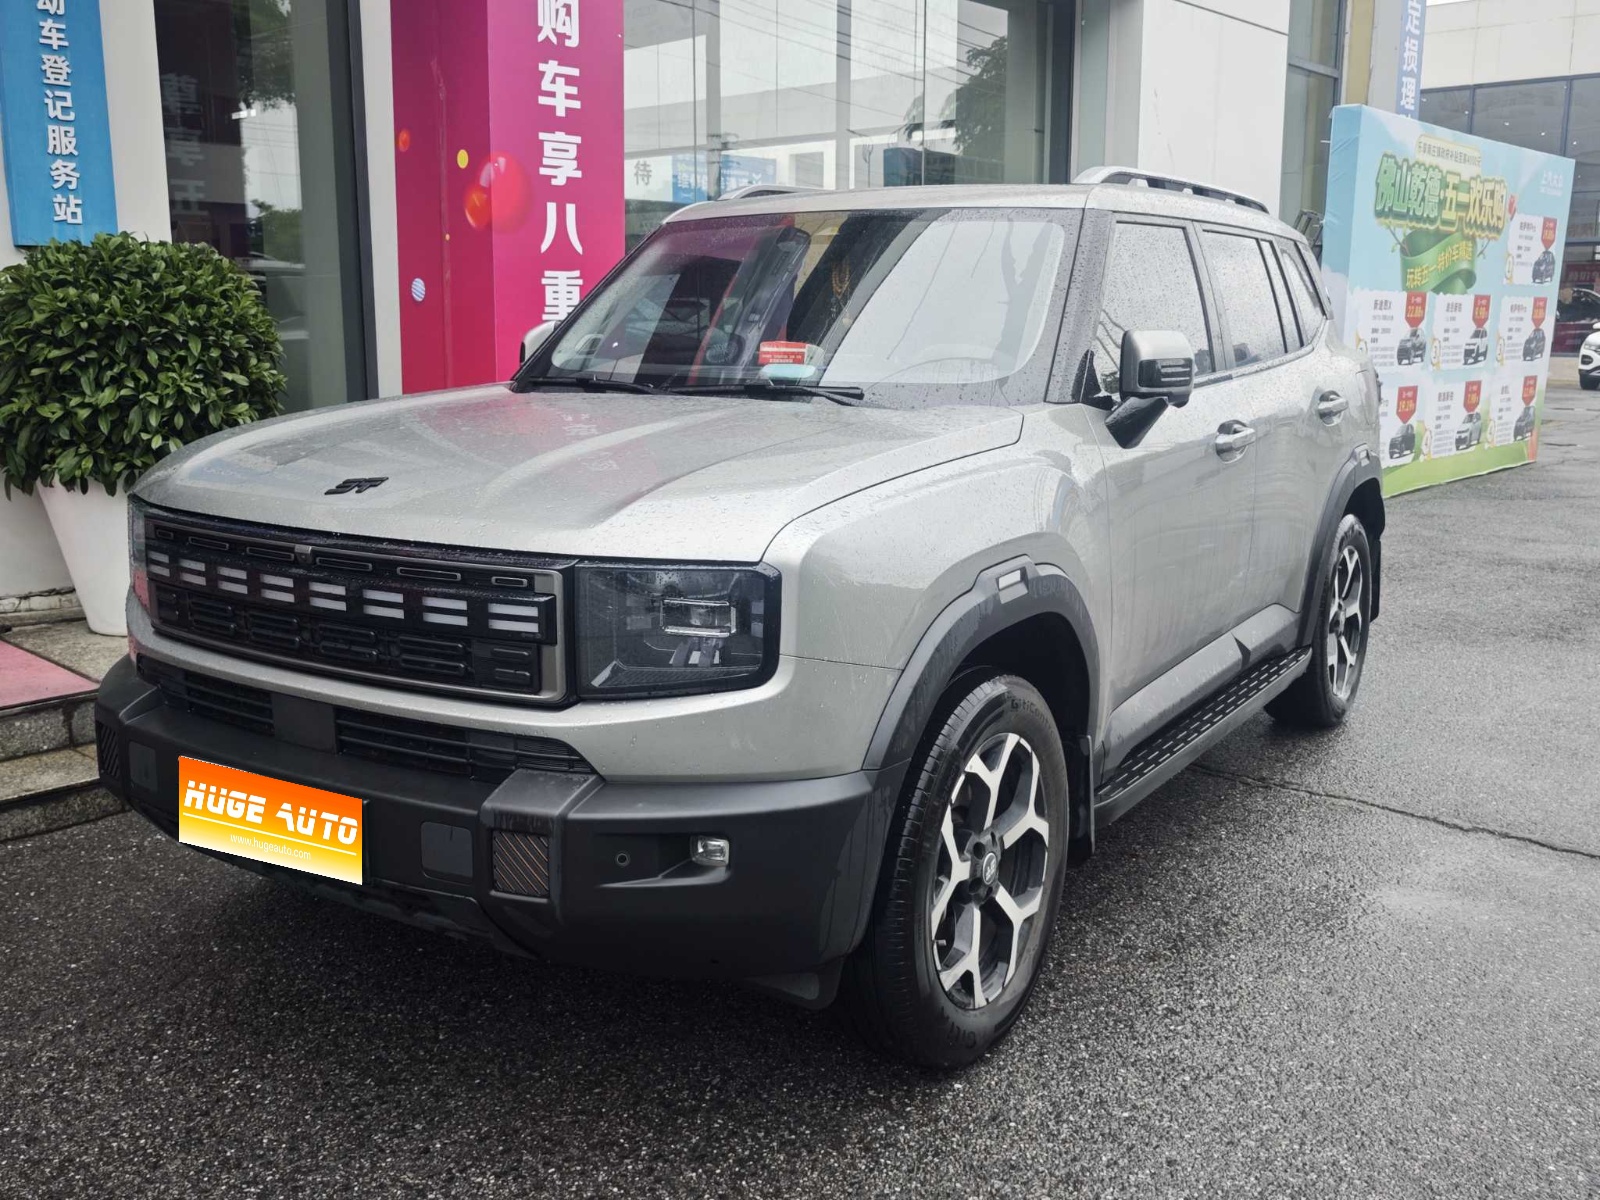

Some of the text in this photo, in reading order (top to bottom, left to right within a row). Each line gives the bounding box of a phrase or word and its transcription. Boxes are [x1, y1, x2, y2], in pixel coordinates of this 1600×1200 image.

[537, 0, 584, 321] 购车享八重
[1400, 0, 1422, 118] 定损理
